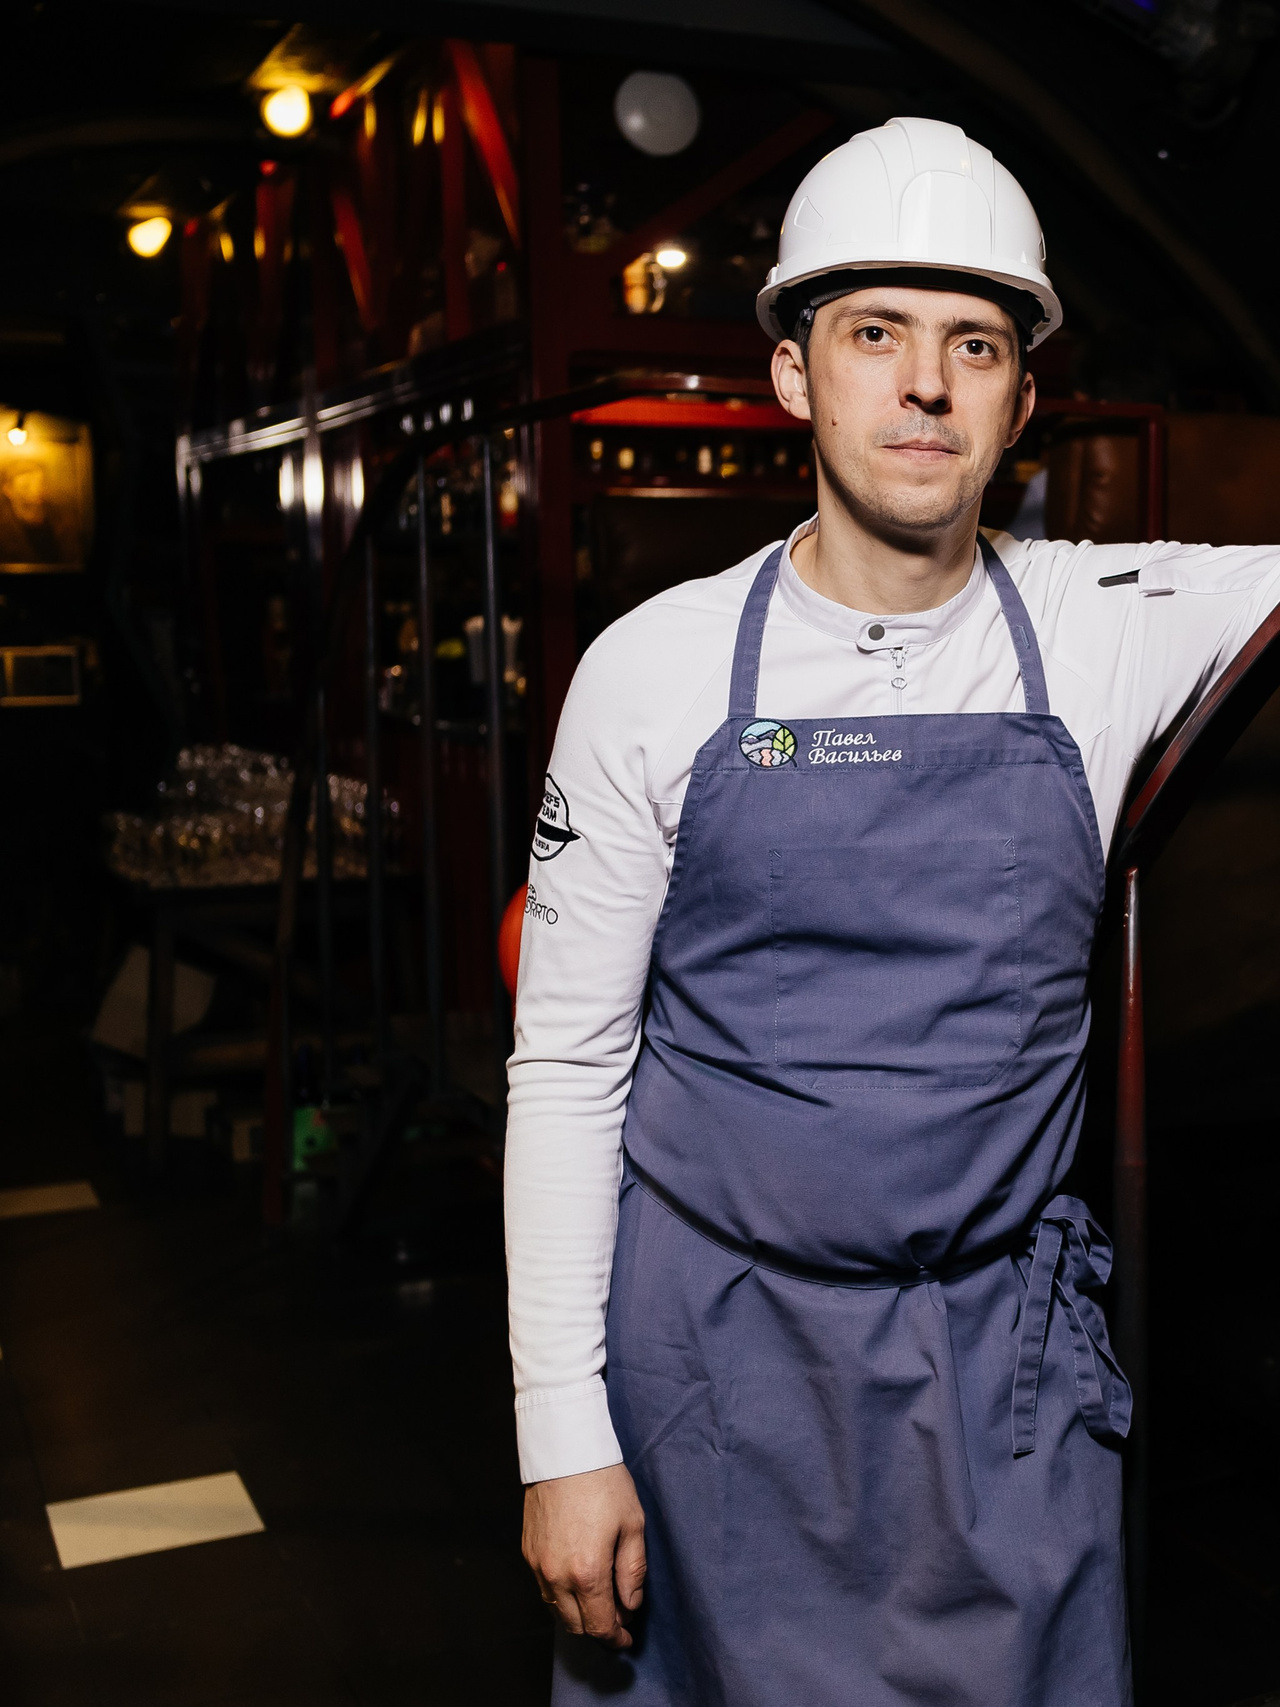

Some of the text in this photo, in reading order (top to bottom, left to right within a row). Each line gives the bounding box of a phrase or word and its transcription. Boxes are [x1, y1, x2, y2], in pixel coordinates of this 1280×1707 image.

[811, 728, 877, 747] Павел
[808, 748, 902, 765] Васильев
[542, 805, 557, 823] EAM
